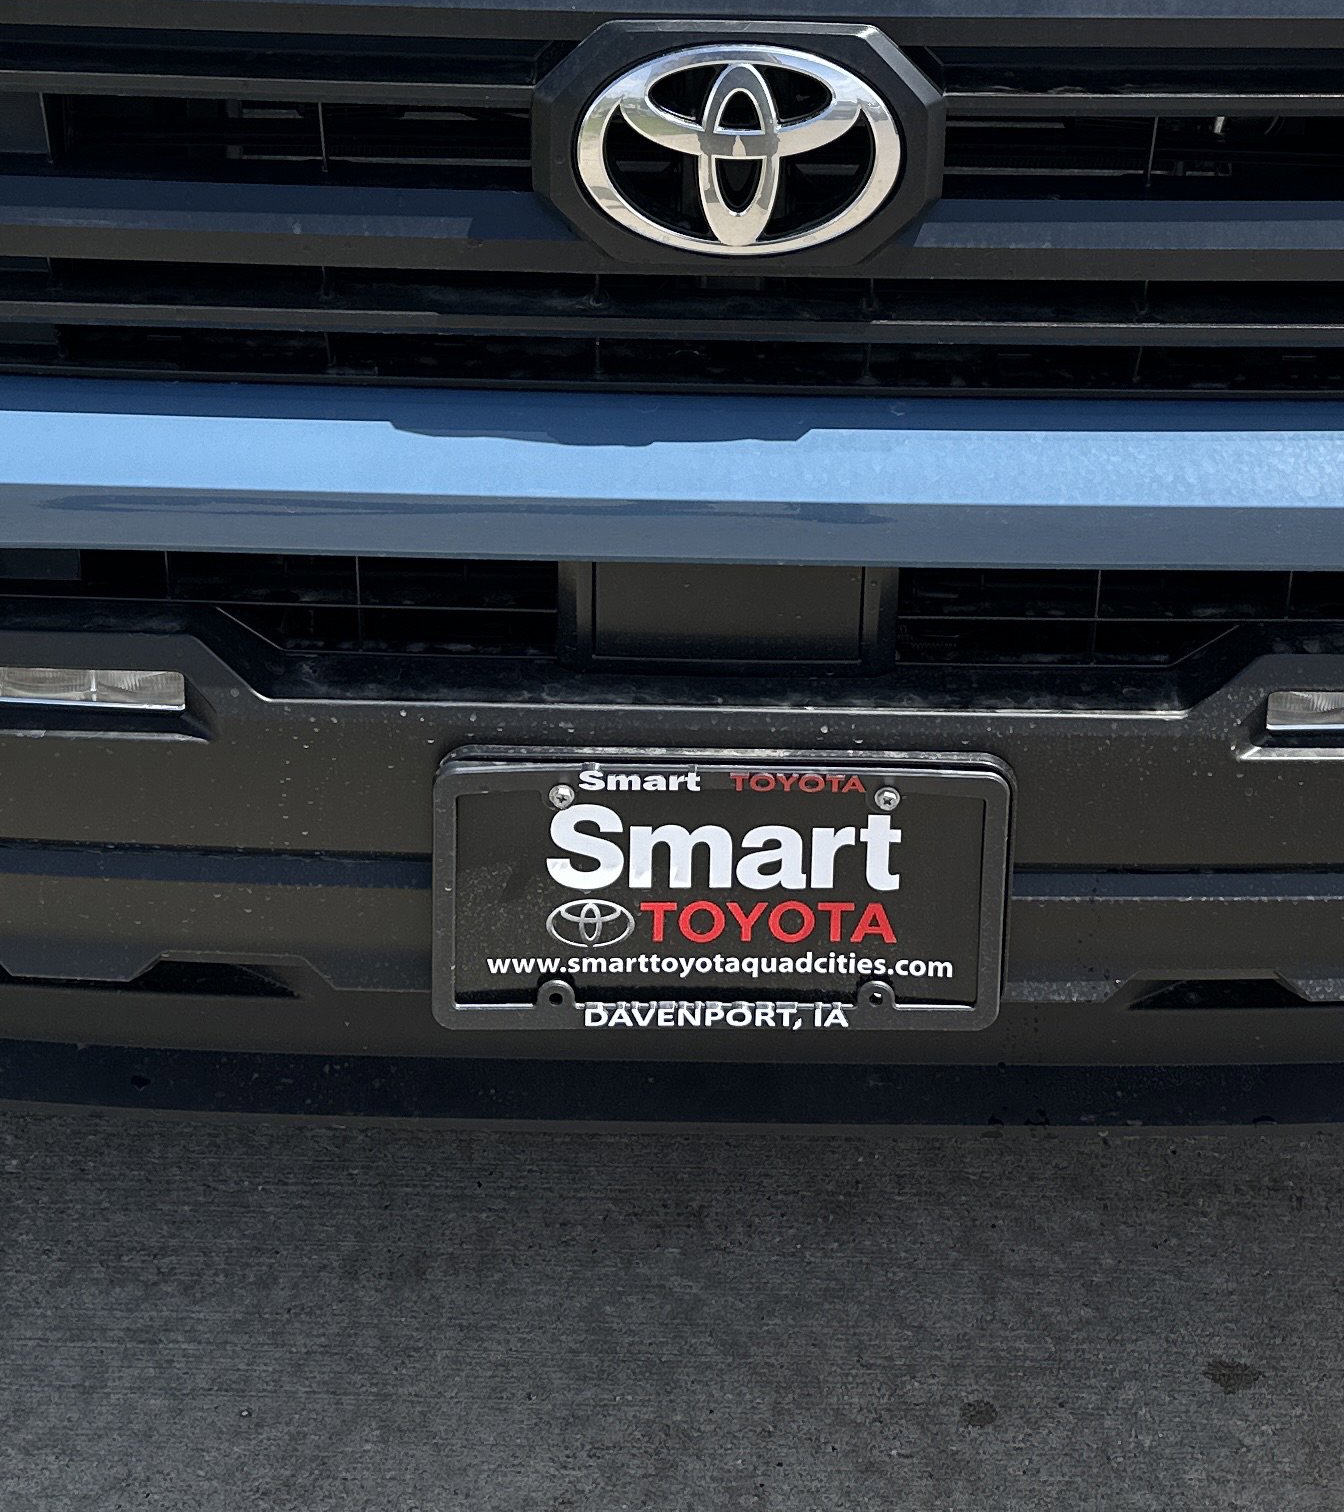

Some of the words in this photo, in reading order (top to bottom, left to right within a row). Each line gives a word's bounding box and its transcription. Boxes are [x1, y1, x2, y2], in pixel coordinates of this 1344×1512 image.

[578, 771, 701, 791] Smart
[730, 772, 866, 793] TOYOTA
[545, 804, 902, 891] Smart
[640, 901, 898, 944] TOYOTA
[487, 951, 954, 978] www.smarttoyotaquadcities.com
[584, 1006, 802, 1030] DAVENPORT,
[813, 1005, 849, 1028] IA
